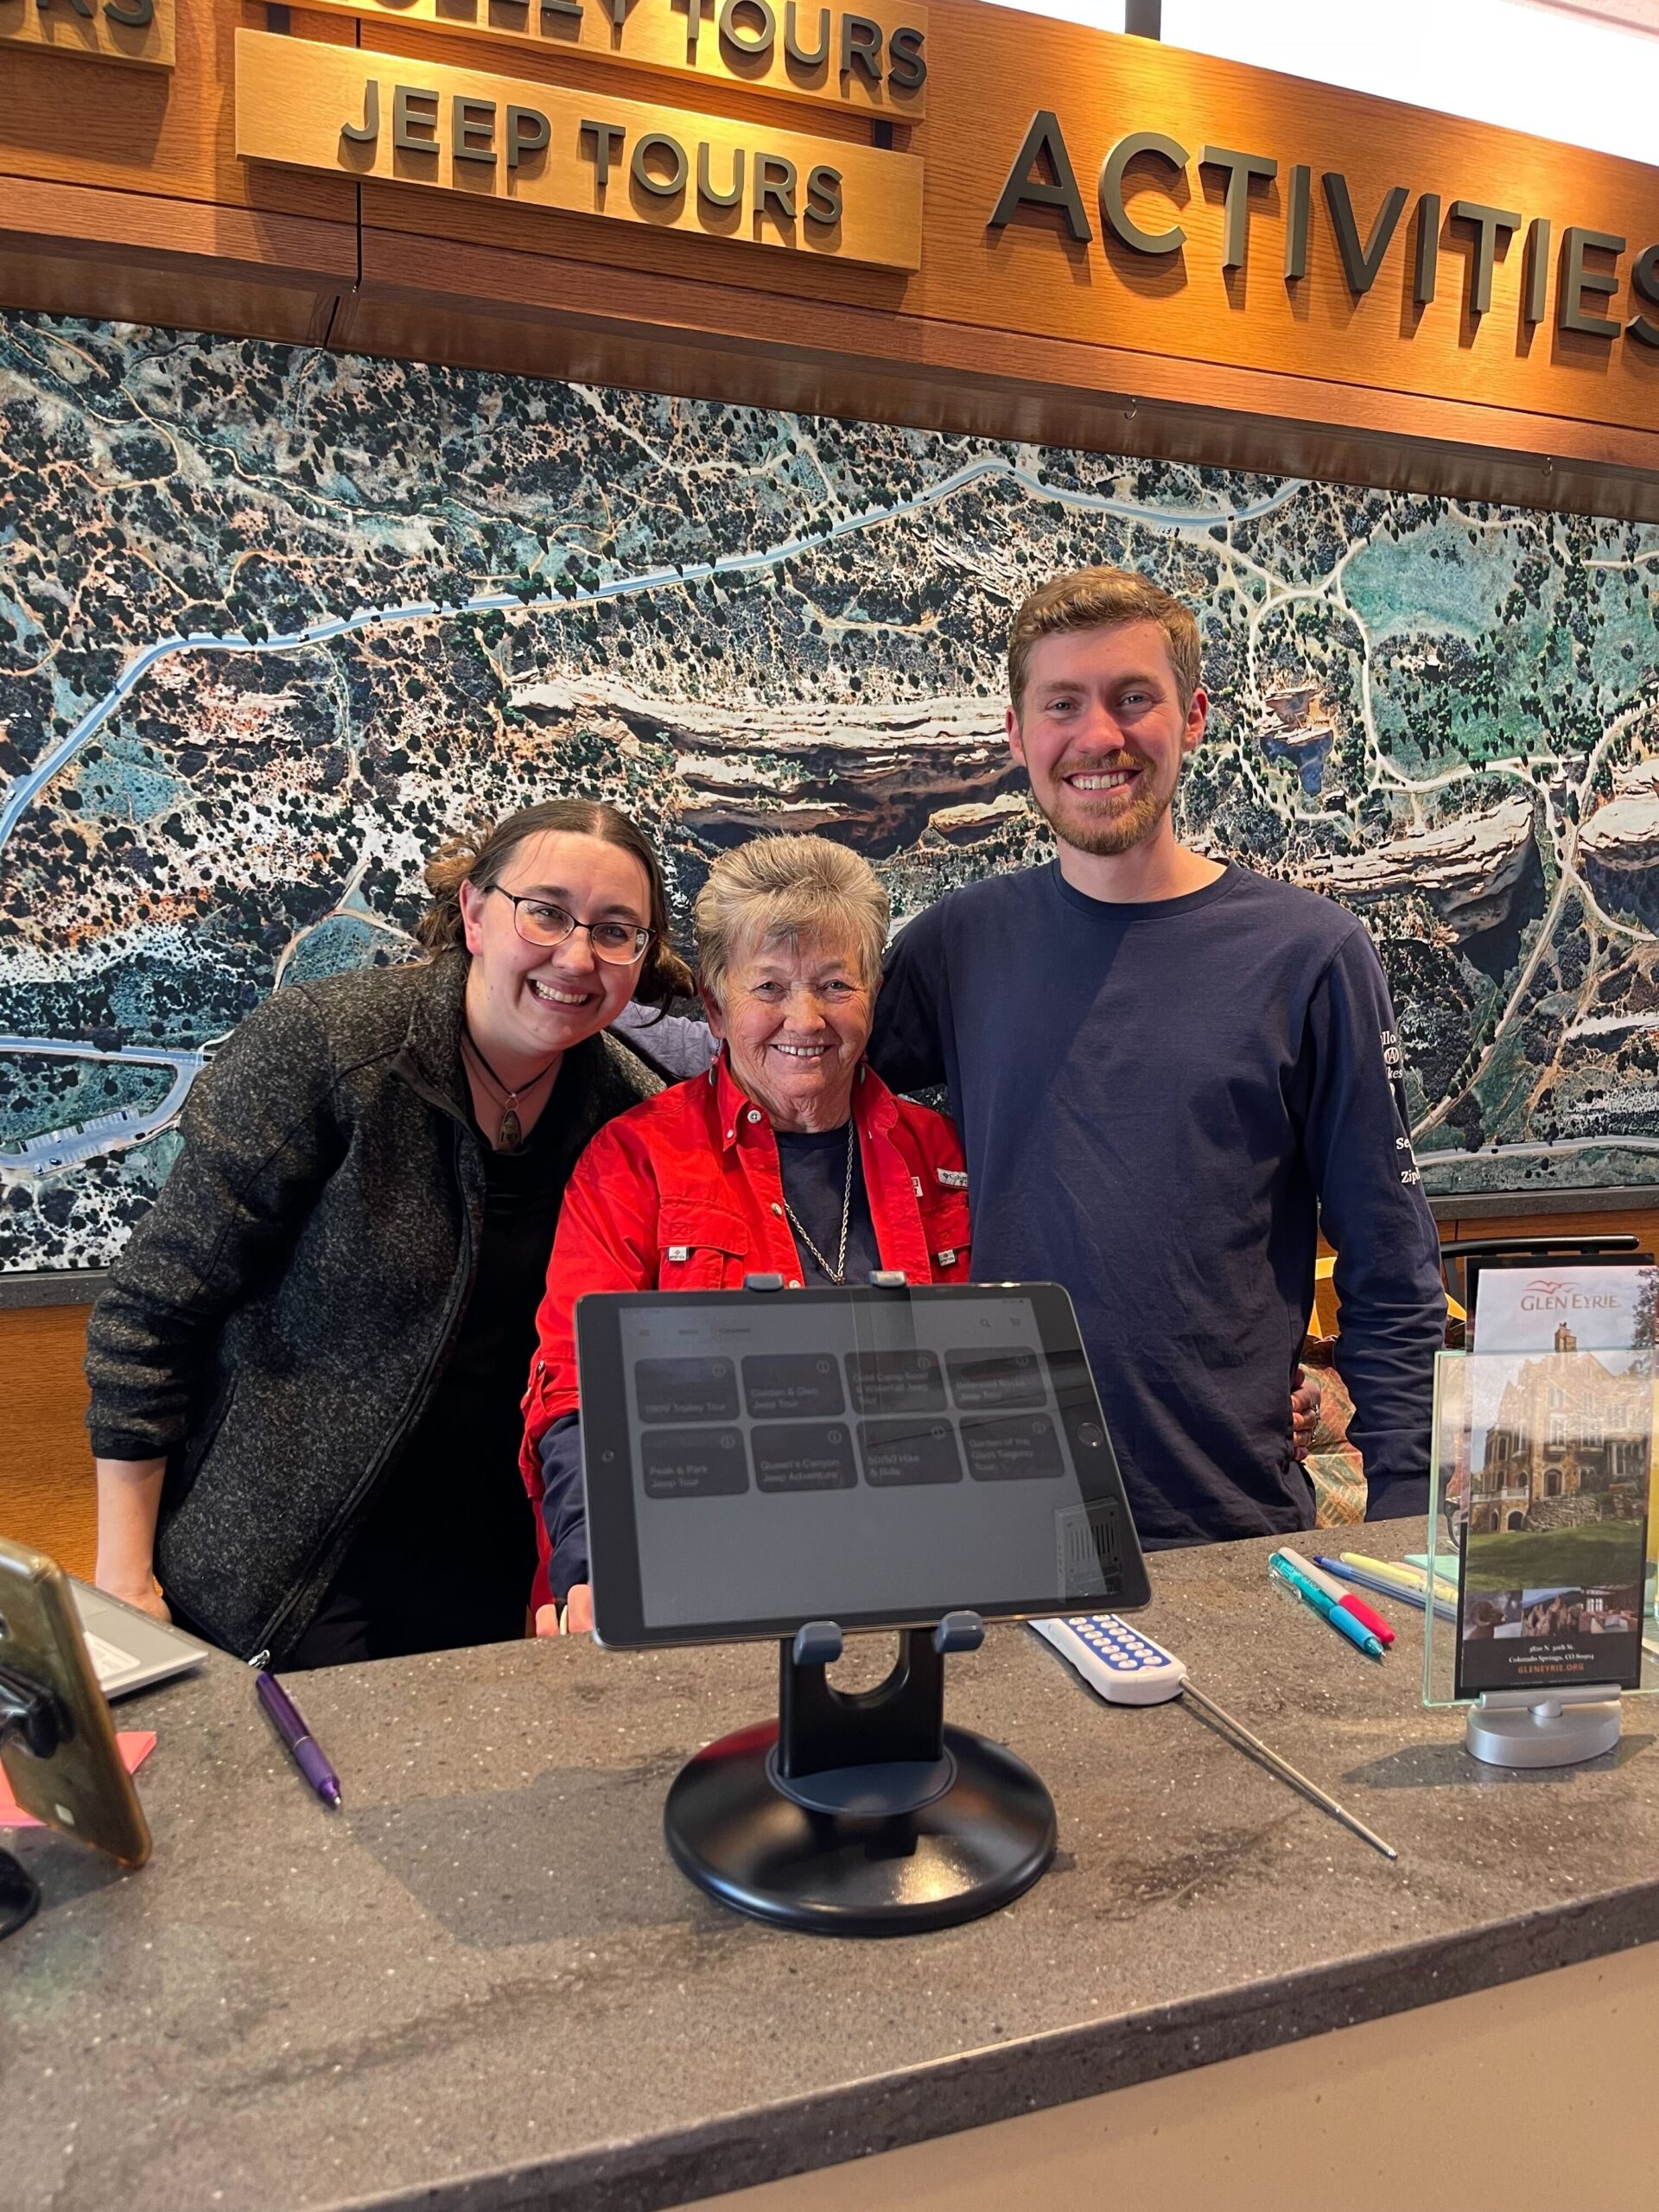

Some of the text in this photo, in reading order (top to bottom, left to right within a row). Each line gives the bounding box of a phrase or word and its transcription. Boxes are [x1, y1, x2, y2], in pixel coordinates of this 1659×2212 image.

[340, 79, 843, 225] JEEP TOURS
[986, 110, 1659, 349] ACTIVITIES
[1521, 1294, 1618, 1312] GLEN EYRIE
[678, 1478, 700, 1486] Tour
[789, 1470, 839, 1481] Adventure
[1518, 1662, 1585, 1674] GLENEYRIE.ORG
